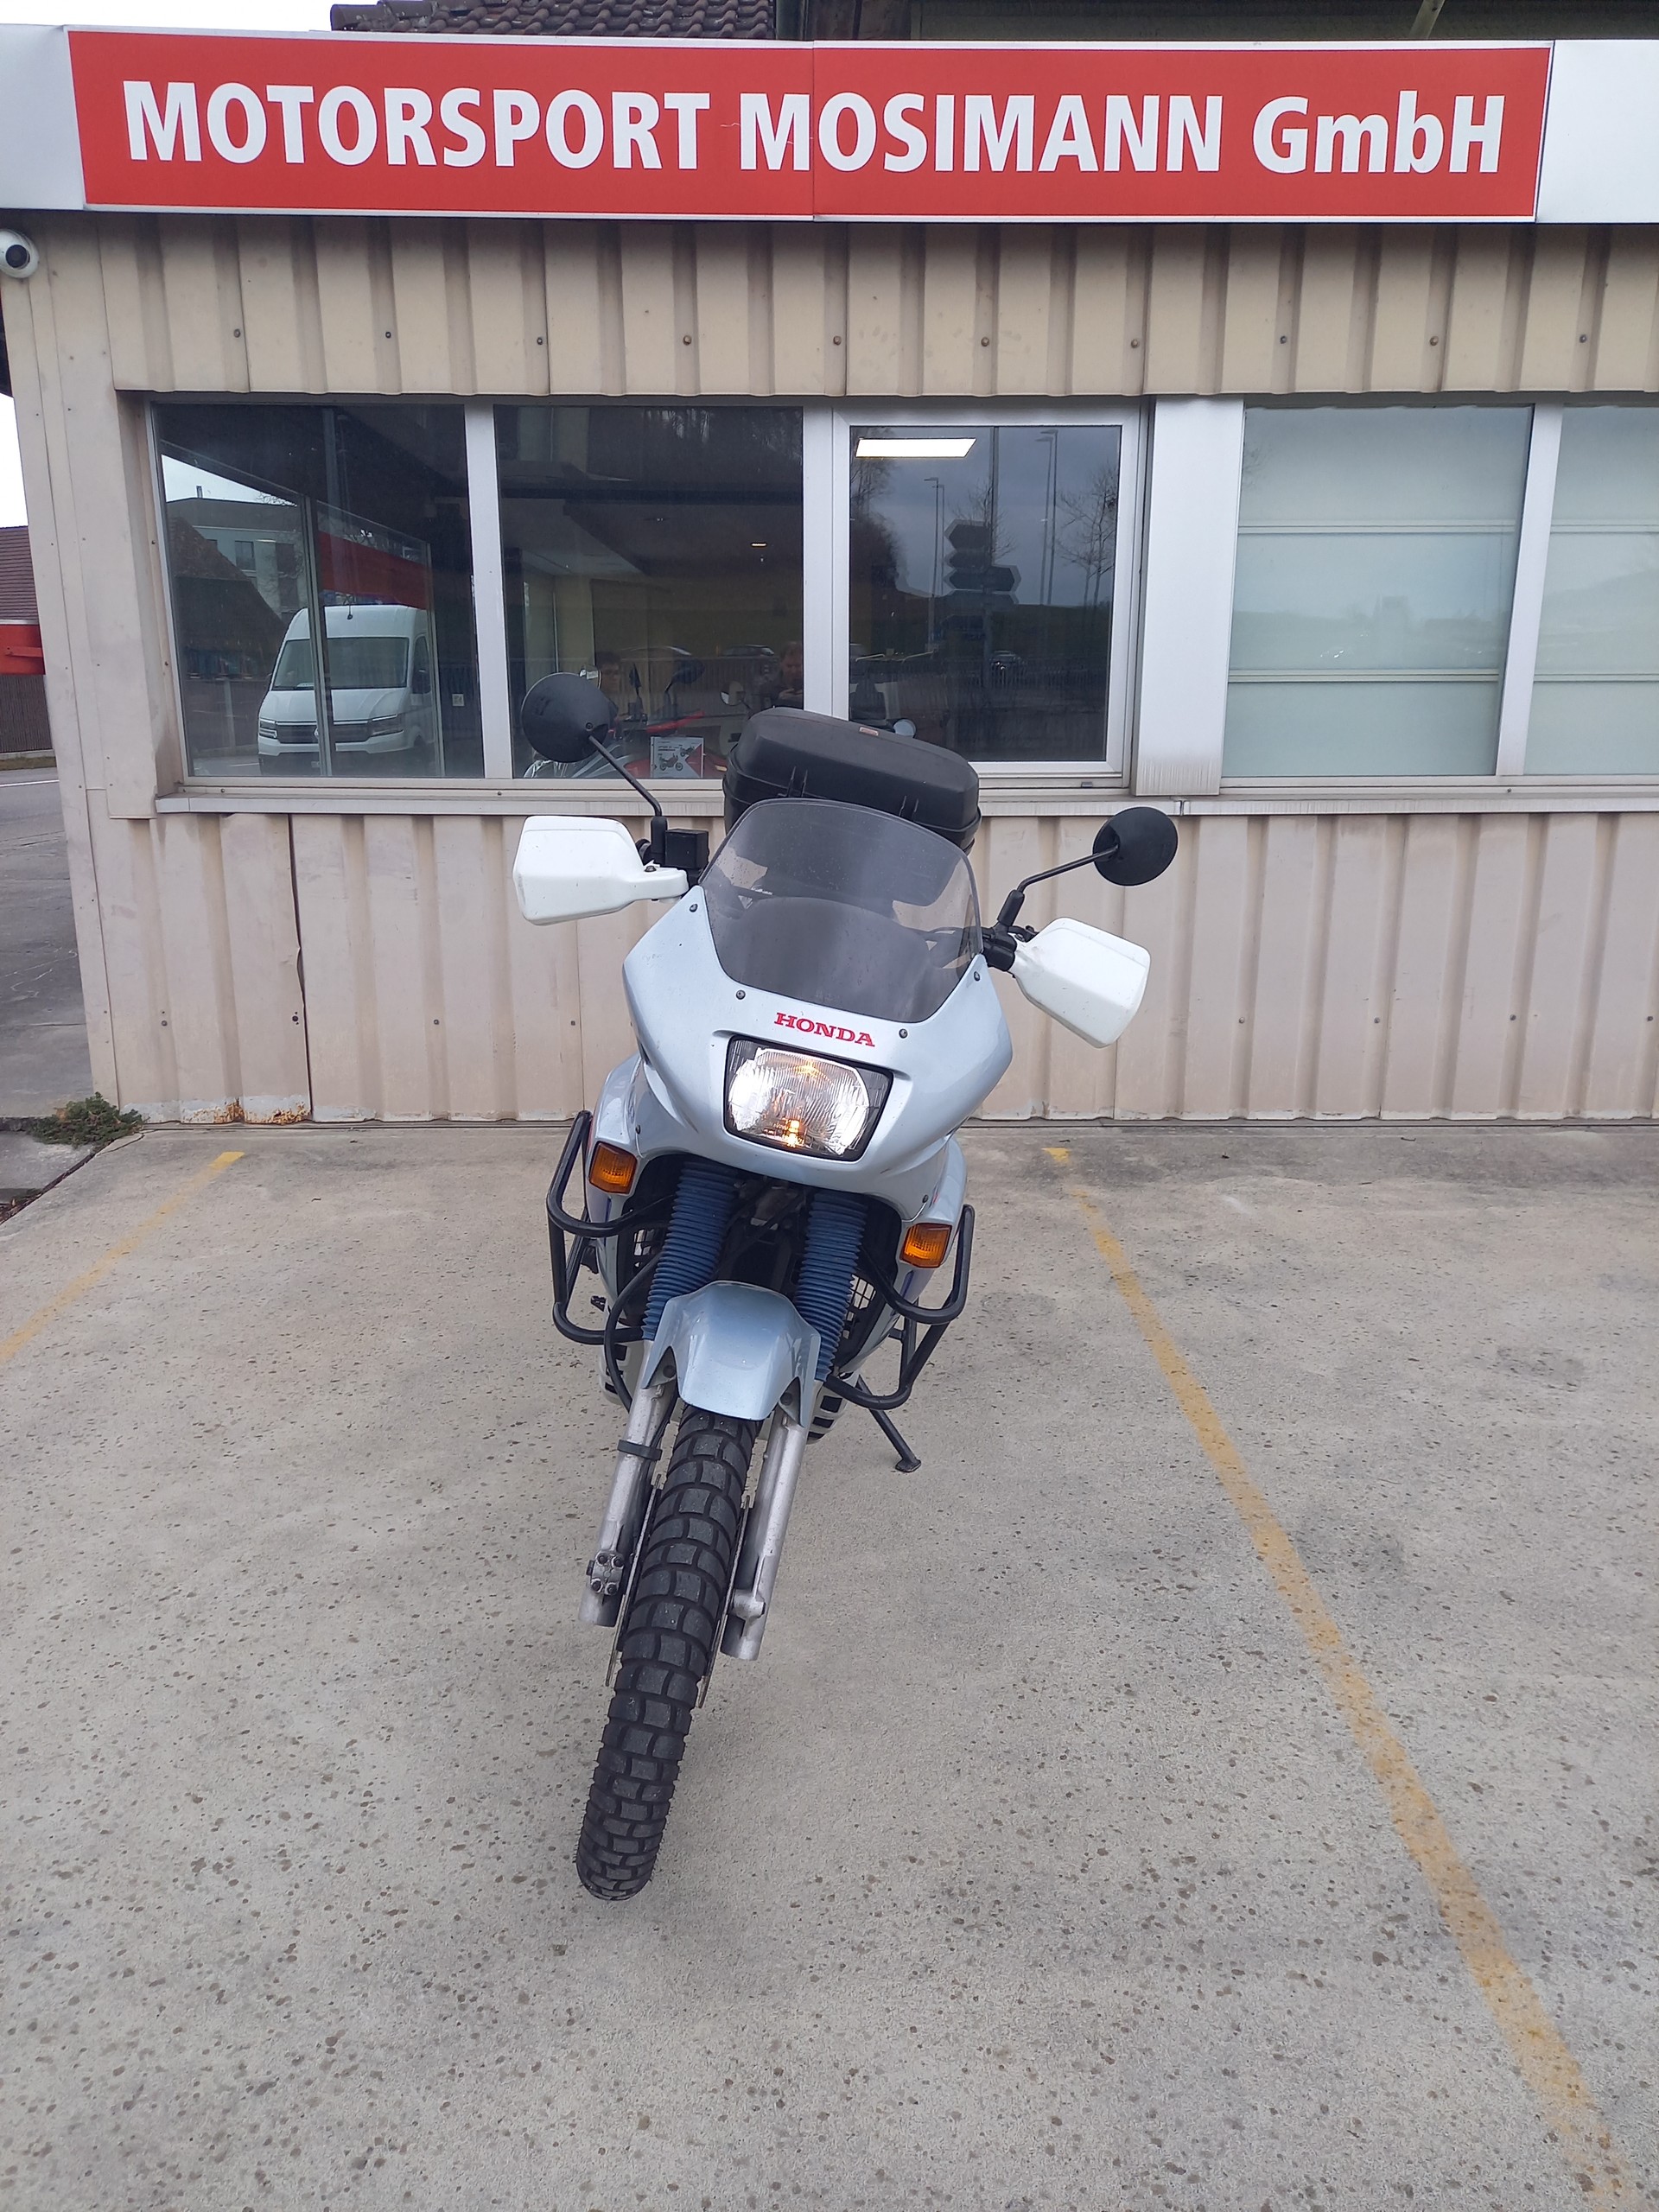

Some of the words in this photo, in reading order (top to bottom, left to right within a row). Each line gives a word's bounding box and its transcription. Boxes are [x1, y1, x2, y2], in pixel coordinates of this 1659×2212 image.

[123, 80, 710, 169] MOTORSPORT
[739, 92, 1224, 174] MOSIMANN
[1253, 90, 1505, 174] GmbH
[774, 1012, 875, 1047] HONDA
